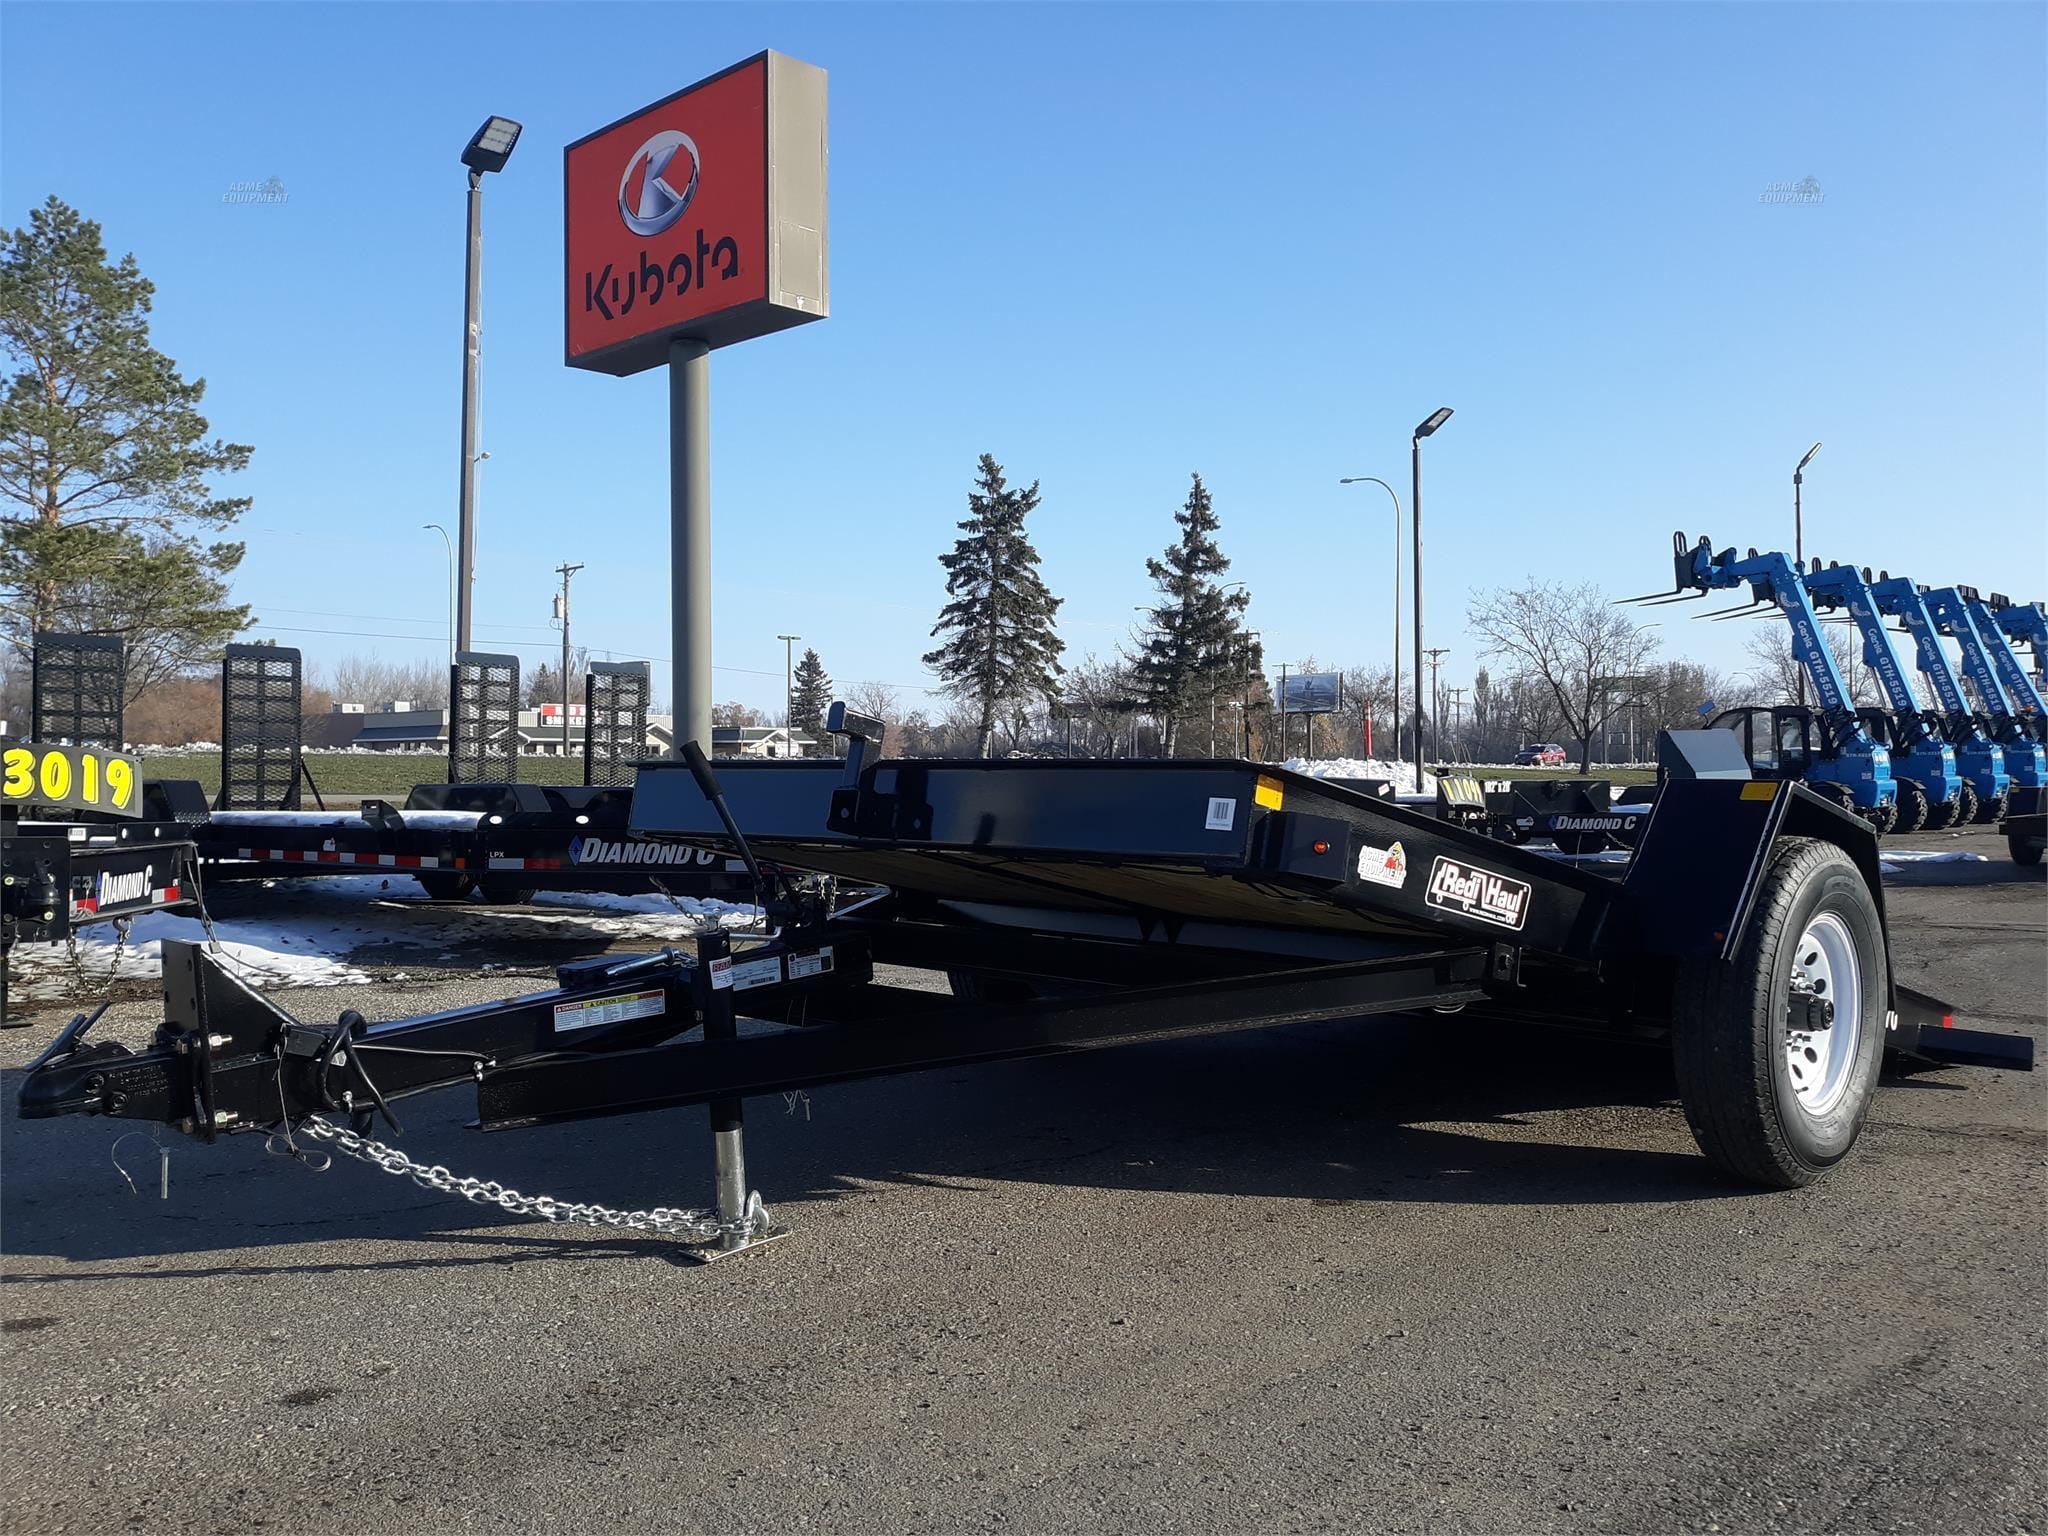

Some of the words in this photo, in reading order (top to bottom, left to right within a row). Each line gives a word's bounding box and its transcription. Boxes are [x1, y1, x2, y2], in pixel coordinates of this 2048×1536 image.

[585, 229, 739, 321] Kubota
[1797, 620, 1813, 649] Genie
[3, 748, 134, 809] 3019
[1555, 815, 1622, 830] DIAMOND
[1624, 815, 1637, 830] C
[580, 838, 693, 865] DIAMOND
[100, 871, 144, 906] DIAMOND
[144, 864, 152, 897] C
[1441, 864, 1482, 900] Redi
[1485, 877, 1523, 913] Haul
